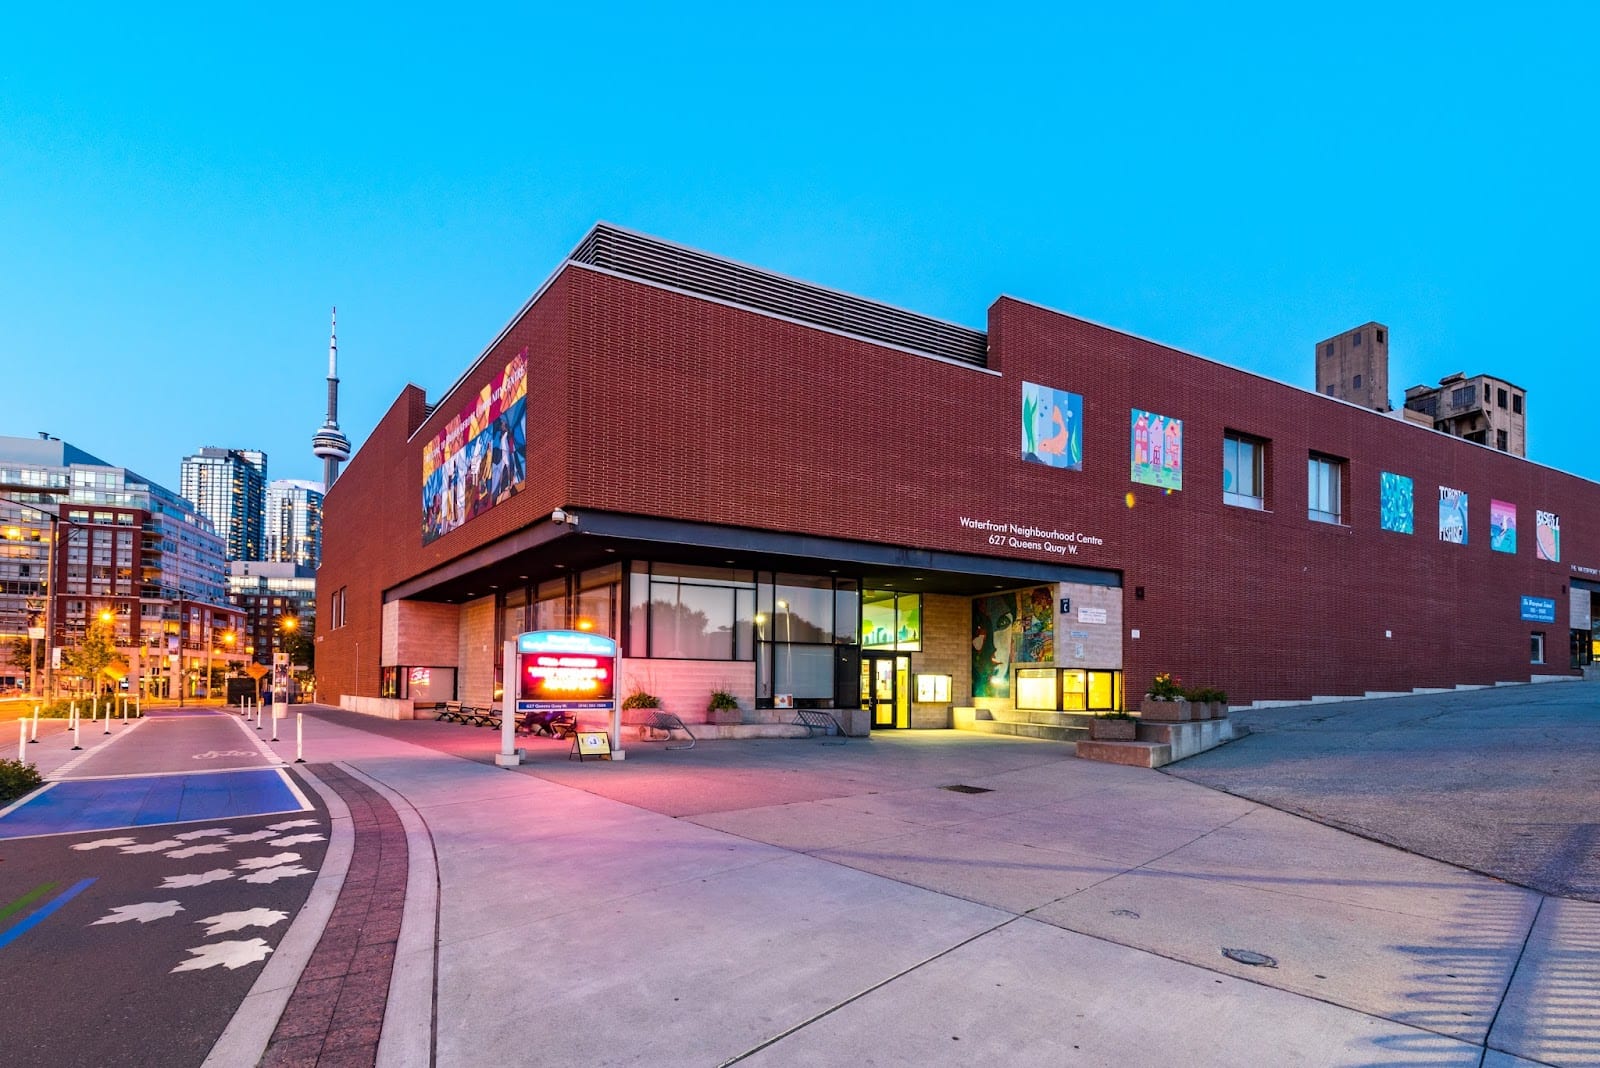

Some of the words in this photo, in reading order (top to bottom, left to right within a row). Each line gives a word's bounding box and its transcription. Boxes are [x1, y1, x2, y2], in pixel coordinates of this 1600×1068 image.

[960, 516, 1008, 533] Waterfront
[1009, 523, 1075, 542] Neighbourhood
[1076, 533, 1103, 546] Centre
[988, 534, 1006, 546] 627
[1008, 537, 1042, 551] Queens
[1043, 541, 1067, 556] Quay
[1068, 545, 1079, 555] W.
